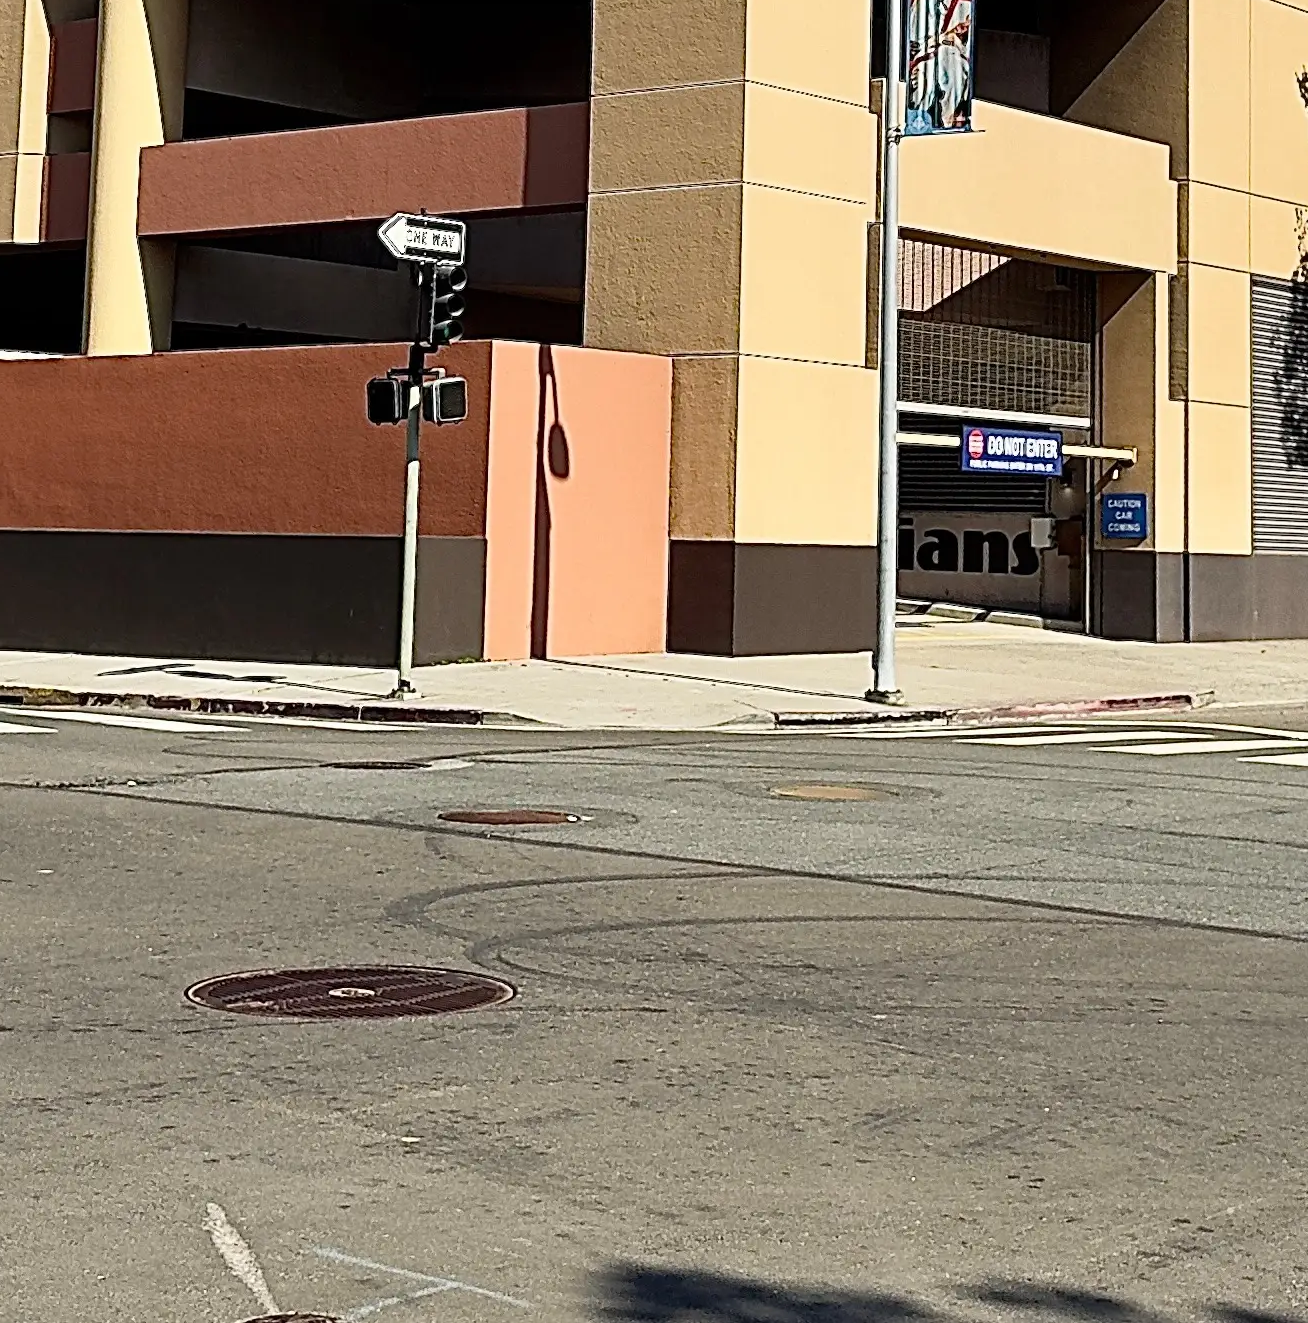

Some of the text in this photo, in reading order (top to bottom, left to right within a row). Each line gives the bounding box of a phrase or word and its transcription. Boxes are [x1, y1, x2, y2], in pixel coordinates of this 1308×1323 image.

[407, 229, 455, 248] ONE WAY
[987, 435, 1004, 456] DO
[1004, 436, 1026, 457] NOT
[1026, 438, 1058, 460] ENTER
[1107, 499, 1142, 508] CAUTION
[1114, 511, 1133, 520] CAR
[1107, 522, 1141, 533] COMING
